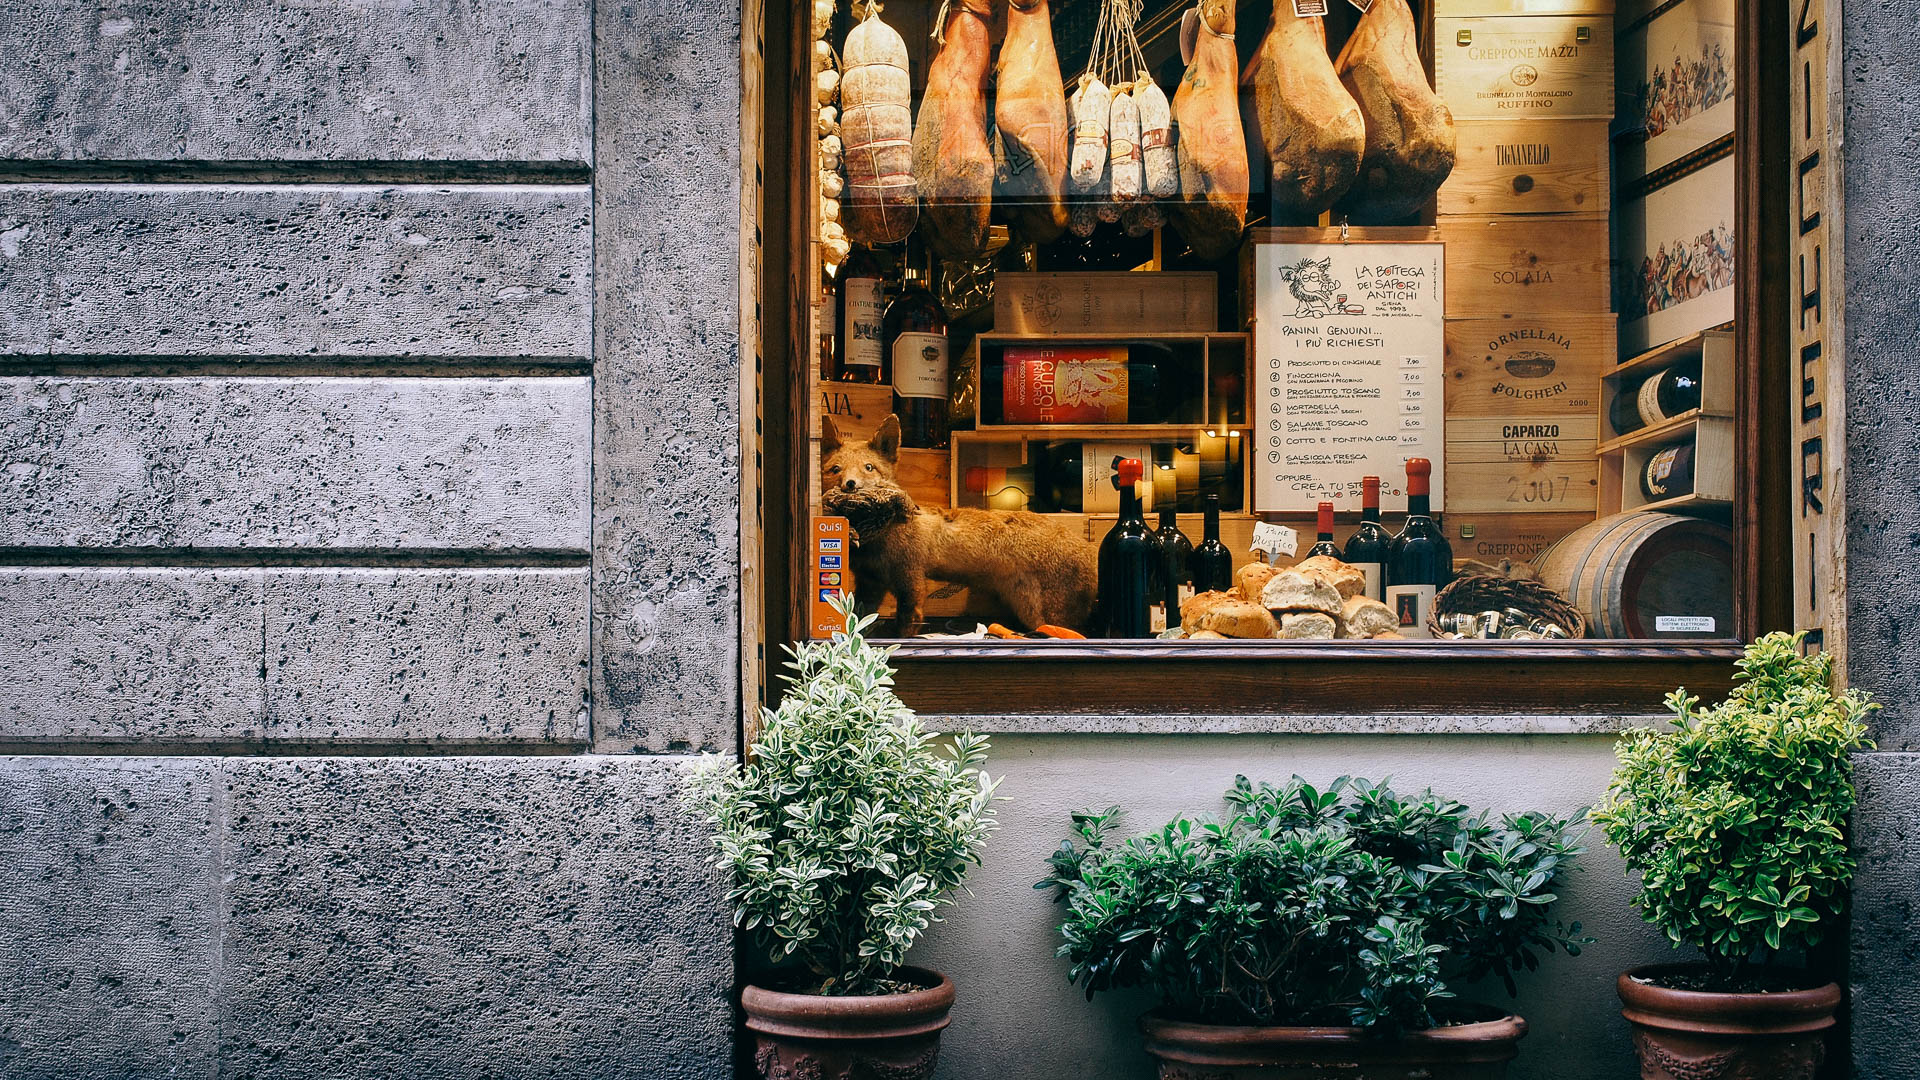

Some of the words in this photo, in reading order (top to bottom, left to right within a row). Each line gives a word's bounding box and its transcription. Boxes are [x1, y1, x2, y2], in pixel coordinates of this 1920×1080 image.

[1468, 46, 1534, 61] GREPPONE
[1537, 45, 1578, 58] MAZZI
[1476, 91, 1515, 99] BRUNELLO
[1526, 90, 1573, 98] MONTALCINO
[1497, 99, 1554, 109] RUFFINO
[1495, 143, 1550, 166] TIGNANELLO
[1355, 265, 1373, 279] LA
[1376, 264, 1425, 277] BOTTEGA
[1493, 270, 1553, 284] SOLAIA
[1357, 281, 1372, 290] DEI
[1375, 279, 1420, 290] SAPORI
[1366, 290, 1417, 300] ANTICHI
[1282, 325, 1319, 336] PANINI
[1327, 325, 1382, 336] GENUINI...
[1296, 339, 1299, 348] I
[1306, 337, 1323, 348] PIÙ
[1326, 339, 1384, 348] RICHIESTI
[1488, 329, 1572, 351] ORNELLAIA
[1040, 360, 1055, 422] CUPOLE
[1287, 388, 1339, 396] PROSCIUTTO
[1341, 387, 1381, 395] TOSCANO
[1495, 380, 1568, 400] BOLGHERI
[1569, 399, 1589, 407] 2000
[1286, 420, 1324, 428] SALAME
[1327, 419, 1369, 427] TOSCANO
[1502, 424, 1560, 438] CAPARZO
[1286, 437, 1316, 445] COTTO
[1503, 441, 1521, 455] LA
[1524, 441, 1560, 455] CASA
[1291, 482, 1325, 490] CREA
[1329, 482, 1344, 490] TU
[1346, 481, 1390, 489] STEO
[1506, 475, 1570, 503] 2007
[1321, 491, 1343, 499] TUO
[1350, 489, 1401, 497] PANO
[819, 523, 834, 532] Qui
[835, 523, 843, 532] Si
[1265, 526, 1289, 537] PANE
